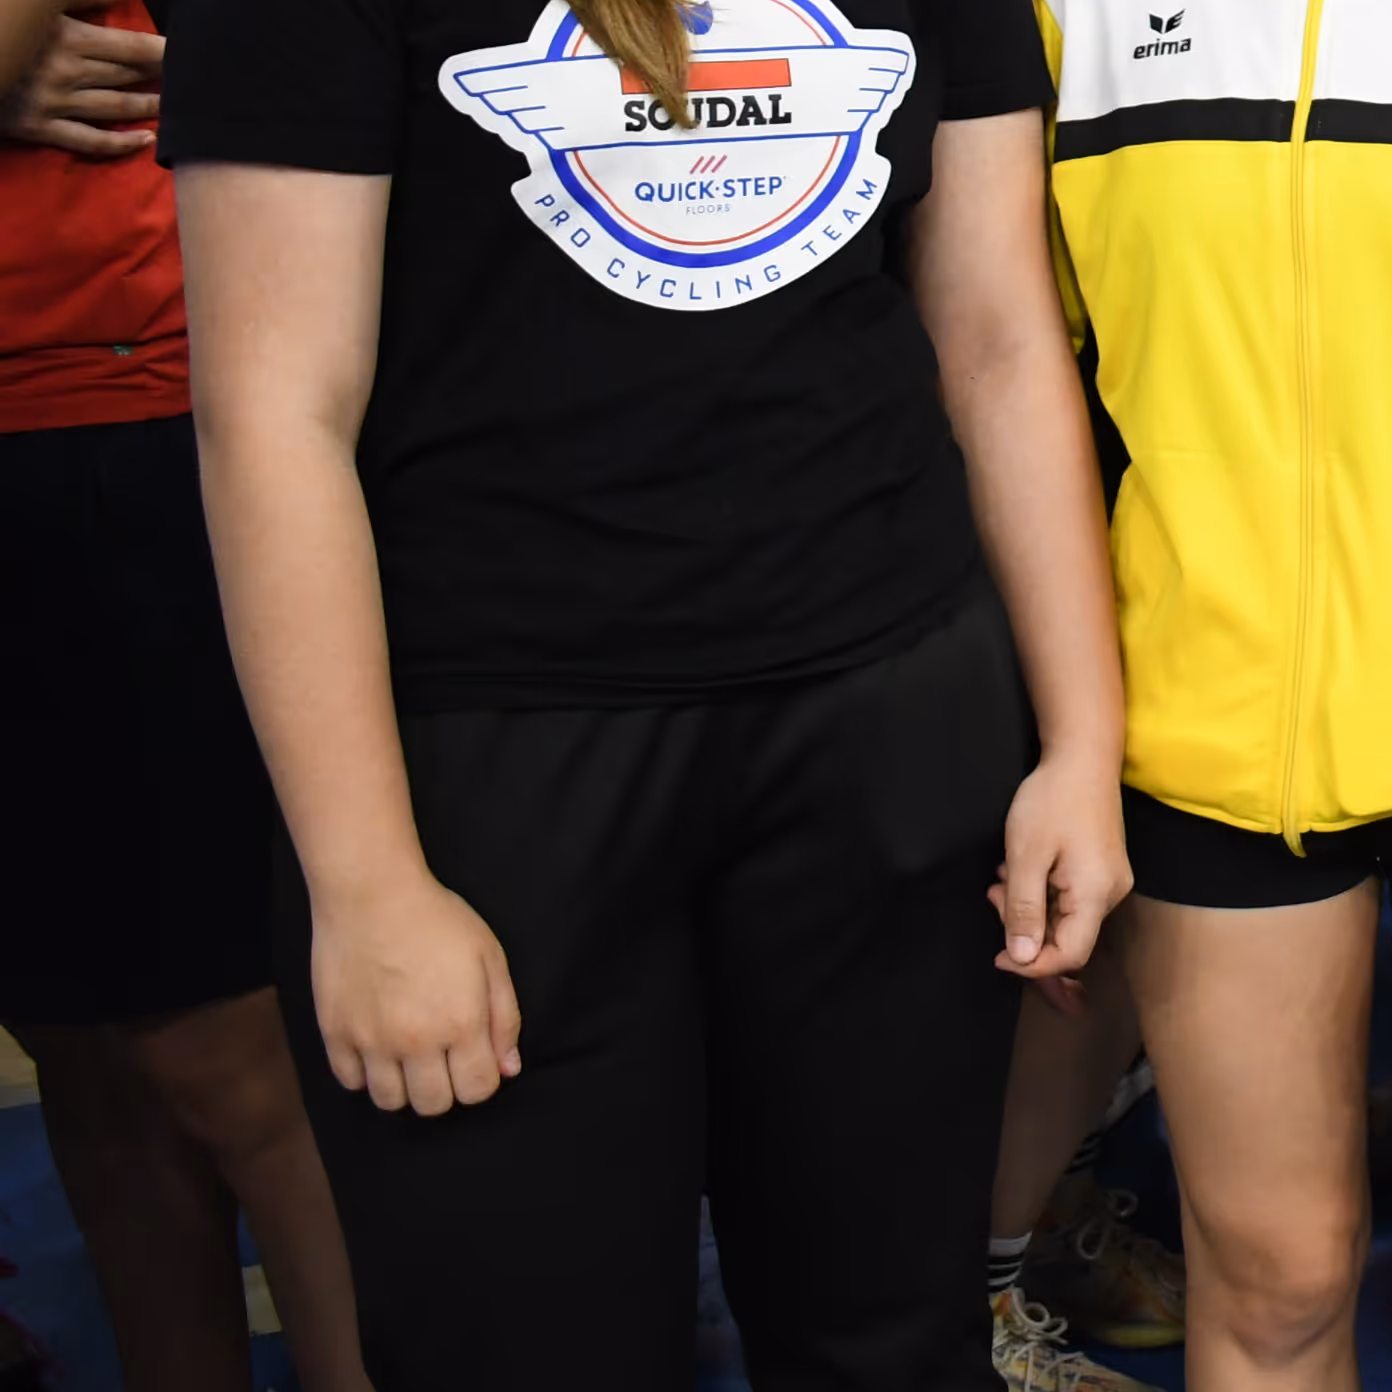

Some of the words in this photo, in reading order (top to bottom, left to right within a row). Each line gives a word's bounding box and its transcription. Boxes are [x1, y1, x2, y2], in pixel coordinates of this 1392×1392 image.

[1133, 36, 1191, 61] erima
[536, 192, 592, 249] PRO
[606, 258, 782, 301] CYCLING
[801, 177, 879, 258] TEAM
